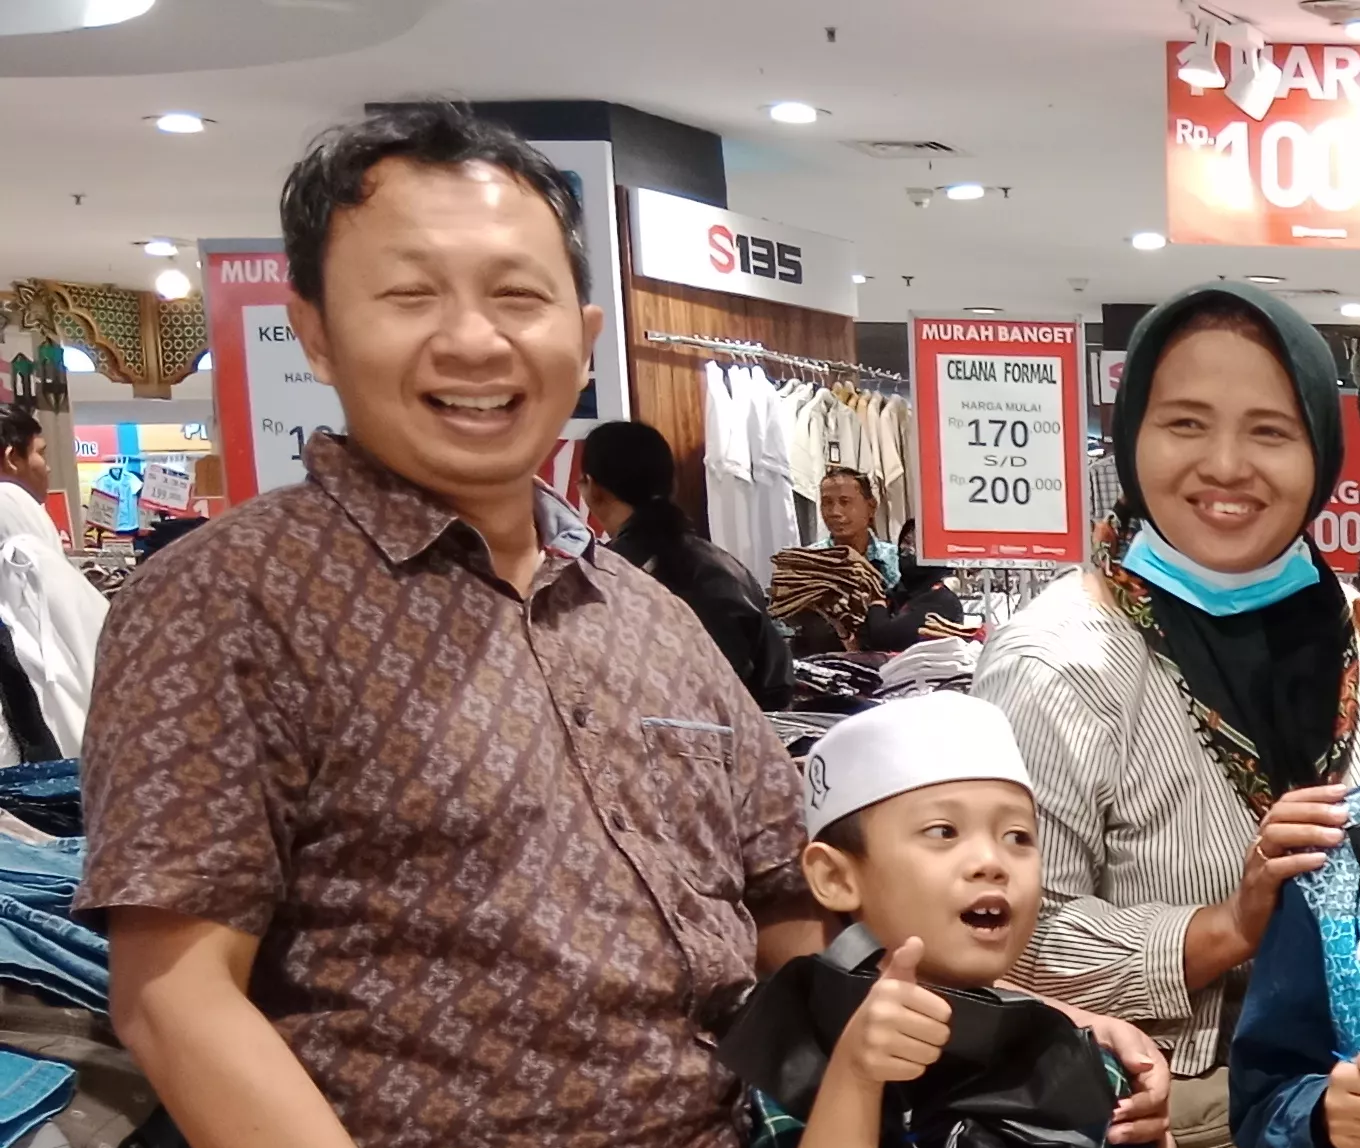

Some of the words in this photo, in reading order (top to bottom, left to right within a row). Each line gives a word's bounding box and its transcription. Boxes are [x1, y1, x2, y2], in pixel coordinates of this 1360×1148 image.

[708, 225, 803, 284] S135
[922, 323, 994, 342] MURAH
[998, 326, 1074, 344] BANGET
[947, 359, 997, 382] CELANA
[1004, 362, 1057, 384] FORMAL
[961, 401, 1003, 411] HARGA
[1005, 402, 1042, 413] MULAI
[983, 454, 1027, 468] S/D
